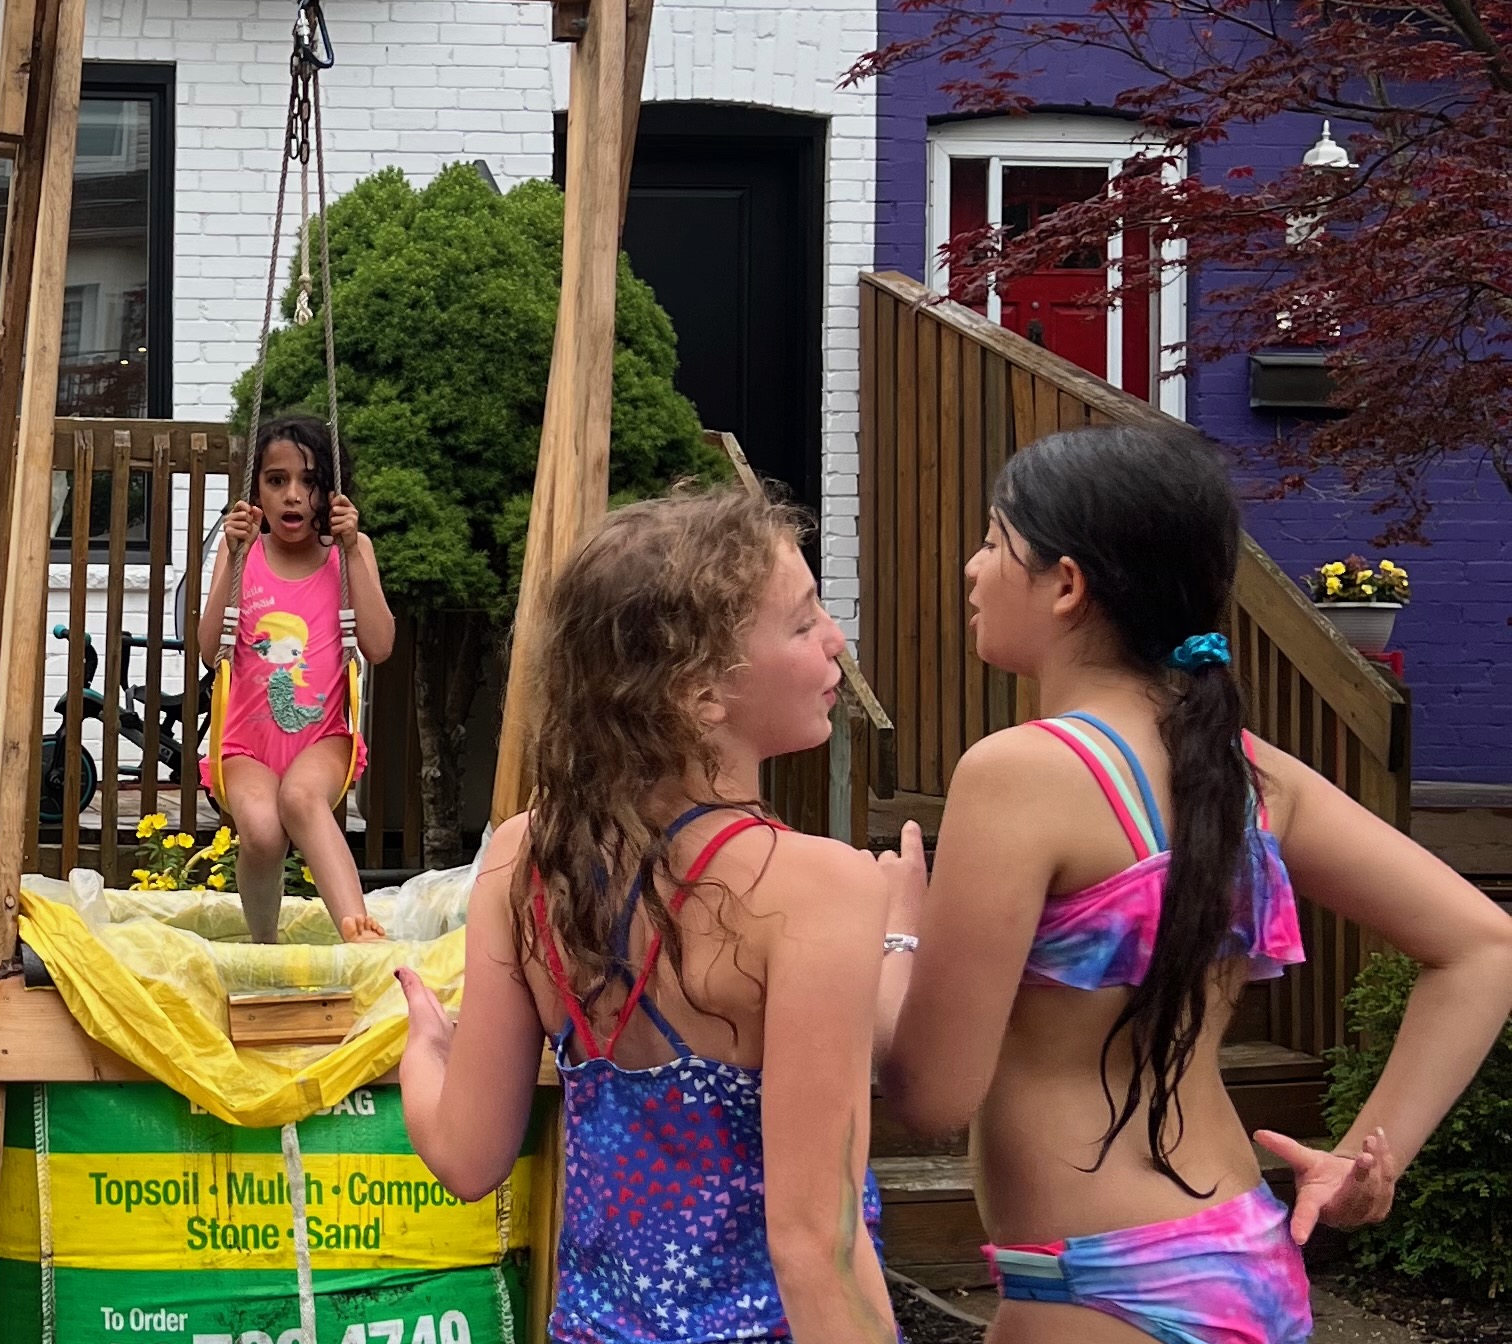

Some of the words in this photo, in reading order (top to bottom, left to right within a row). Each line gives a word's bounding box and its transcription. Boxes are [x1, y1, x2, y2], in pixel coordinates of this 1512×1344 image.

[314, 1088, 376, 1116] AG
[88, 1172, 200, 1213] Topsoil
[187, 1216, 280, 1250] Stone
[306, 1216, 381, 1250] Sand
[100, 1306, 125, 1331] To
[129, 1307, 189, 1332] Order
